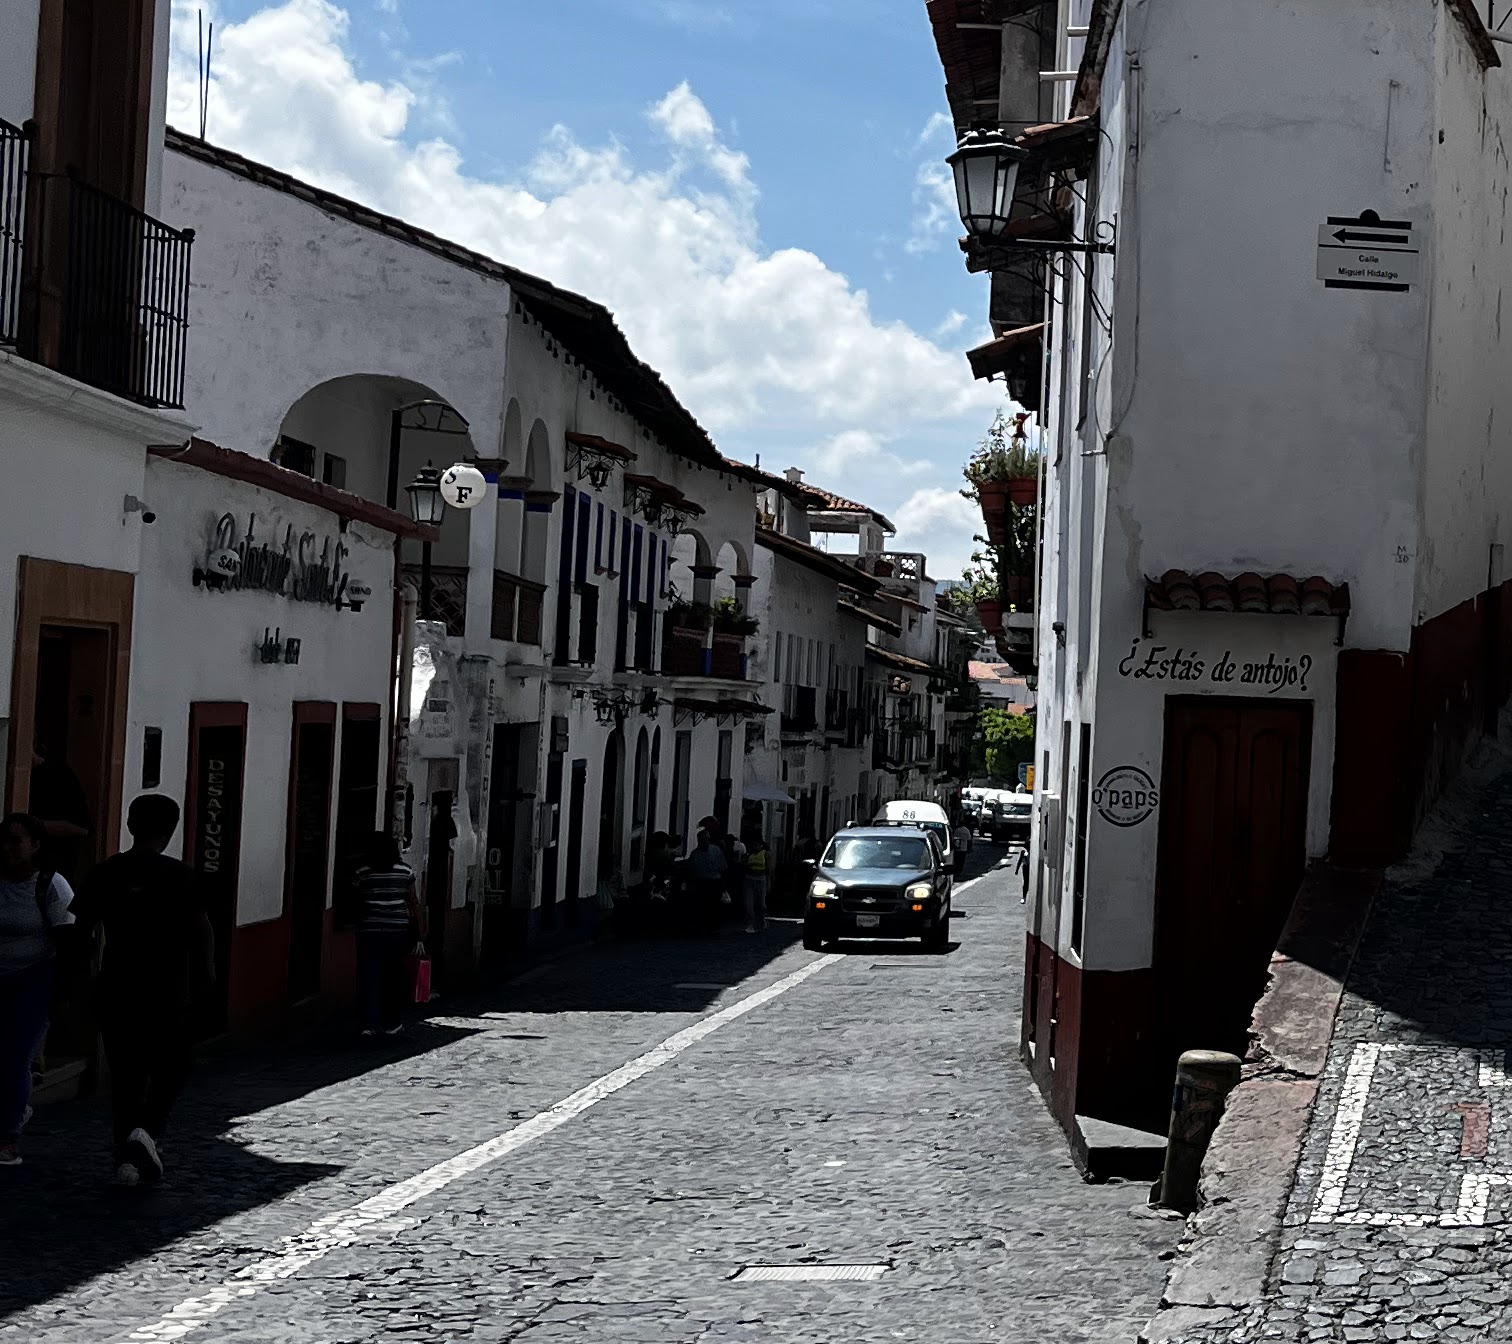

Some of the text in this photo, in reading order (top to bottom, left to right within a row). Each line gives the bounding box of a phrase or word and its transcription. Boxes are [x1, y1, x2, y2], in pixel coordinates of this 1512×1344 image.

[1338, 267, 1399, 280] Miguel Hidalgo
[1358, 254, 1379, 264] Calle
[1118, 637, 1313, 694] ¿Estás de antojo?
[204, 759, 225, 873] DESAYUNOS
